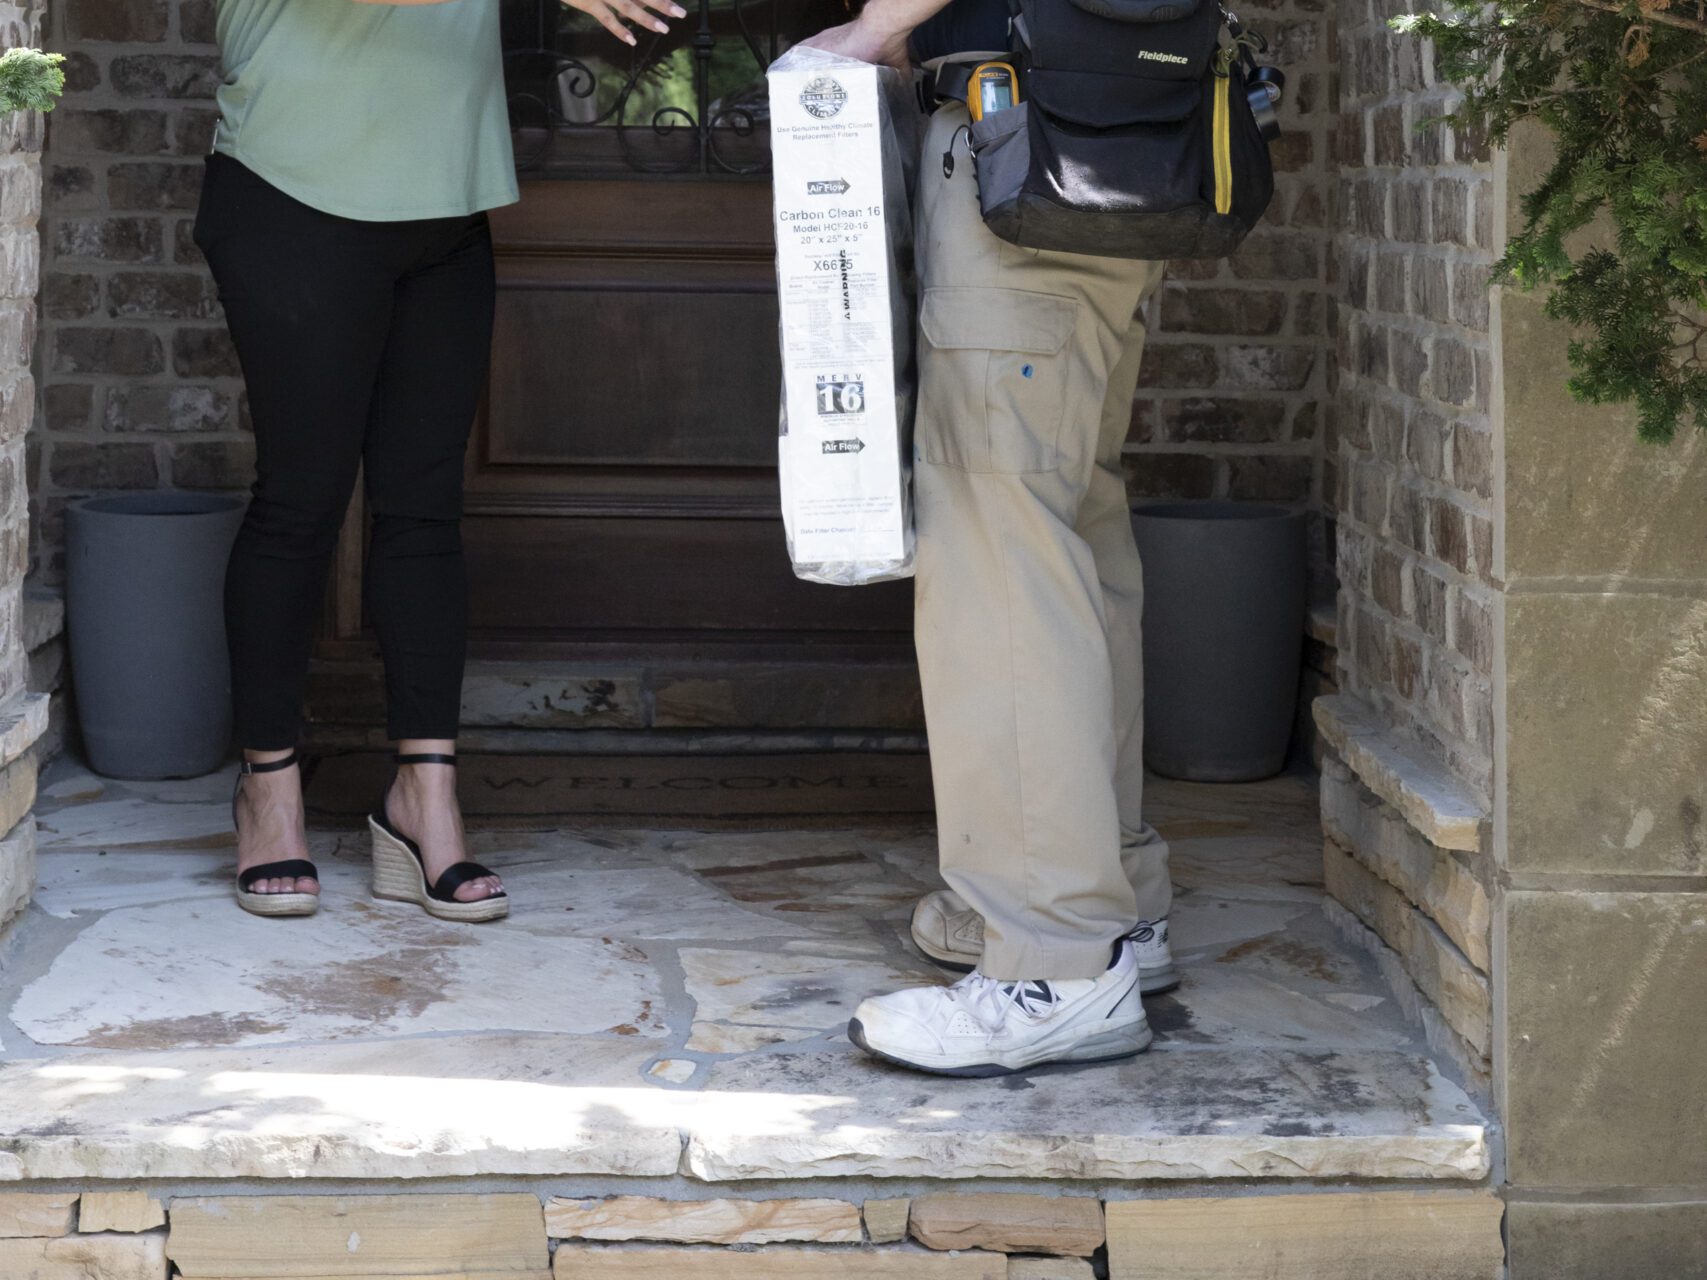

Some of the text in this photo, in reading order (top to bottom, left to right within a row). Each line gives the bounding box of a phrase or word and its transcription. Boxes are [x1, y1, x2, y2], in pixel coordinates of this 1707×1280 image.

[1137, 50, 1188, 64] Fieldpiece
[809, 183, 845, 193] Air Flow
[779, 206, 881, 221] Carbon Clean 16
[793, 224, 821, 233] Model
[819, 383, 862, 412] 16
[823, 441, 860, 452] Air Flow
[480, 775, 909, 790] WELCOME
